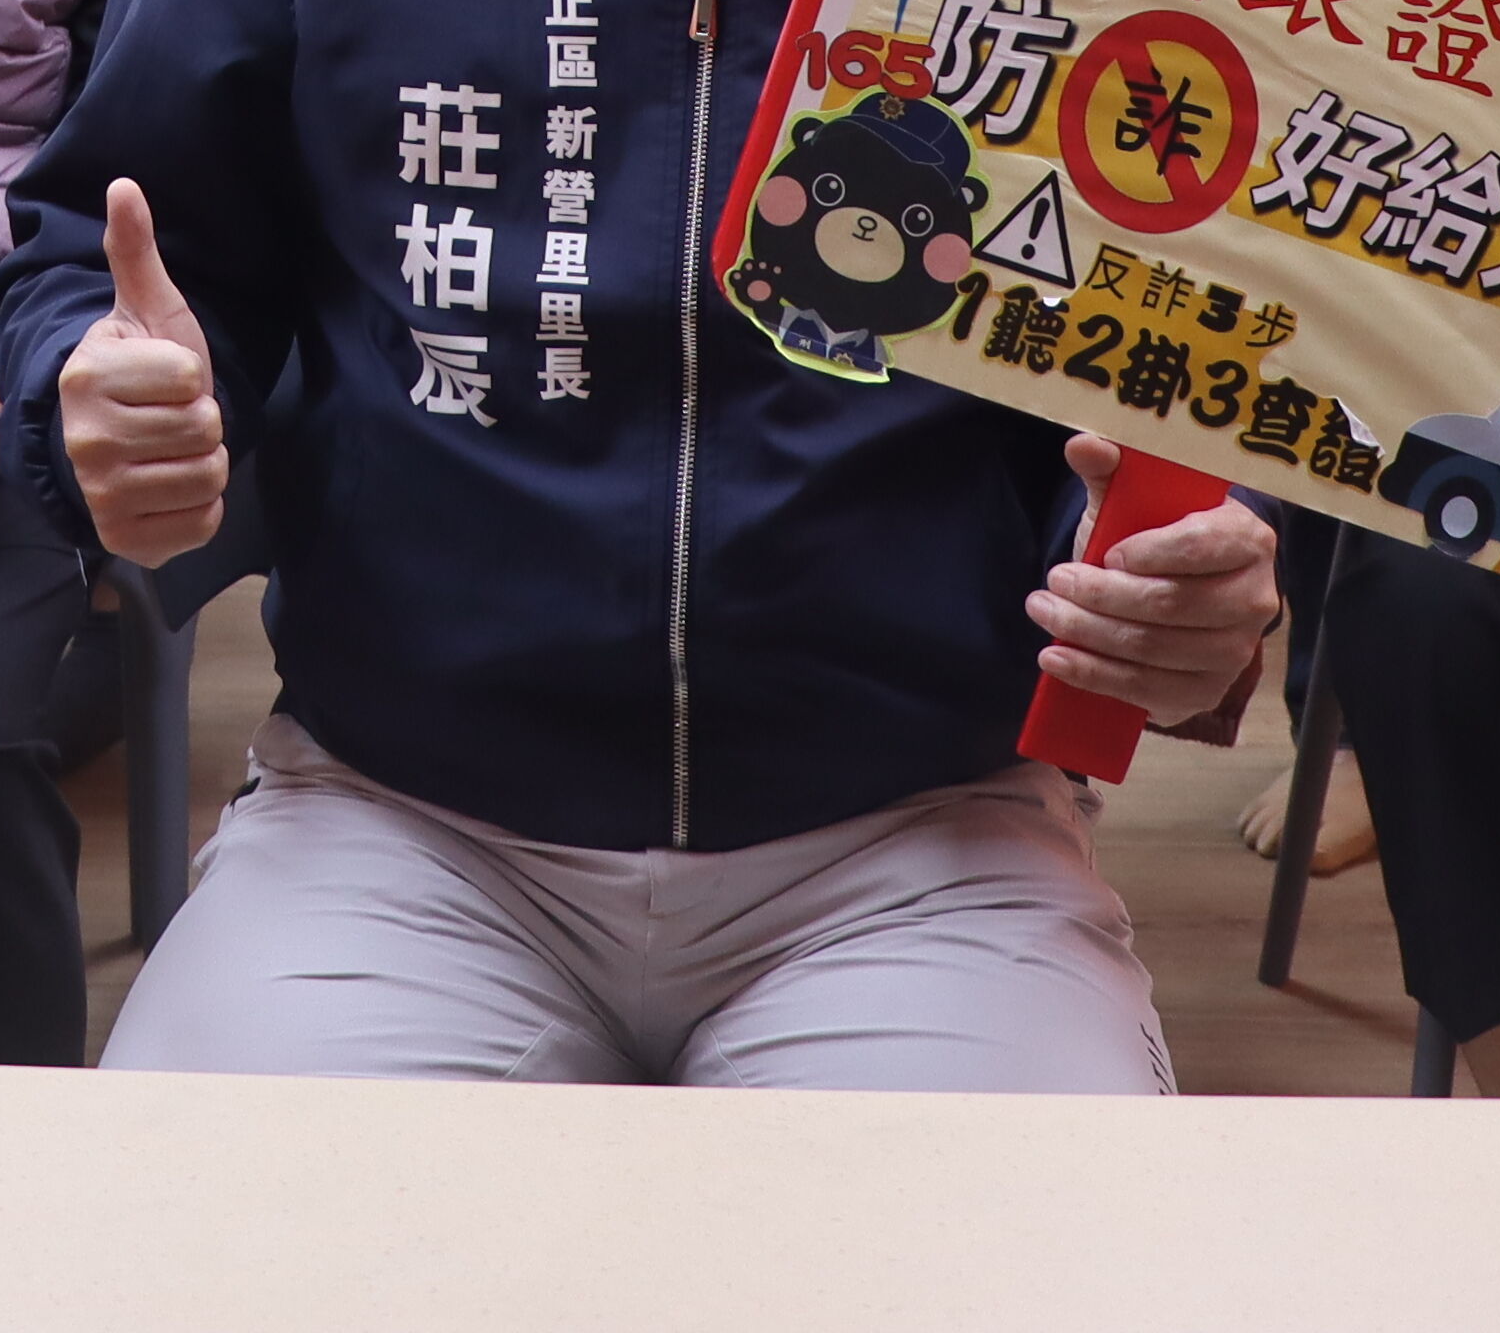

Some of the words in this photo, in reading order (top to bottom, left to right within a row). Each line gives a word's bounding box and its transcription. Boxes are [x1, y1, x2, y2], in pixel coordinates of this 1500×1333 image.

[796, 30, 937, 100] 165
[395, 81, 503, 428] 莊柏辰
[1084, 245, 1297, 350] 反詐3步
